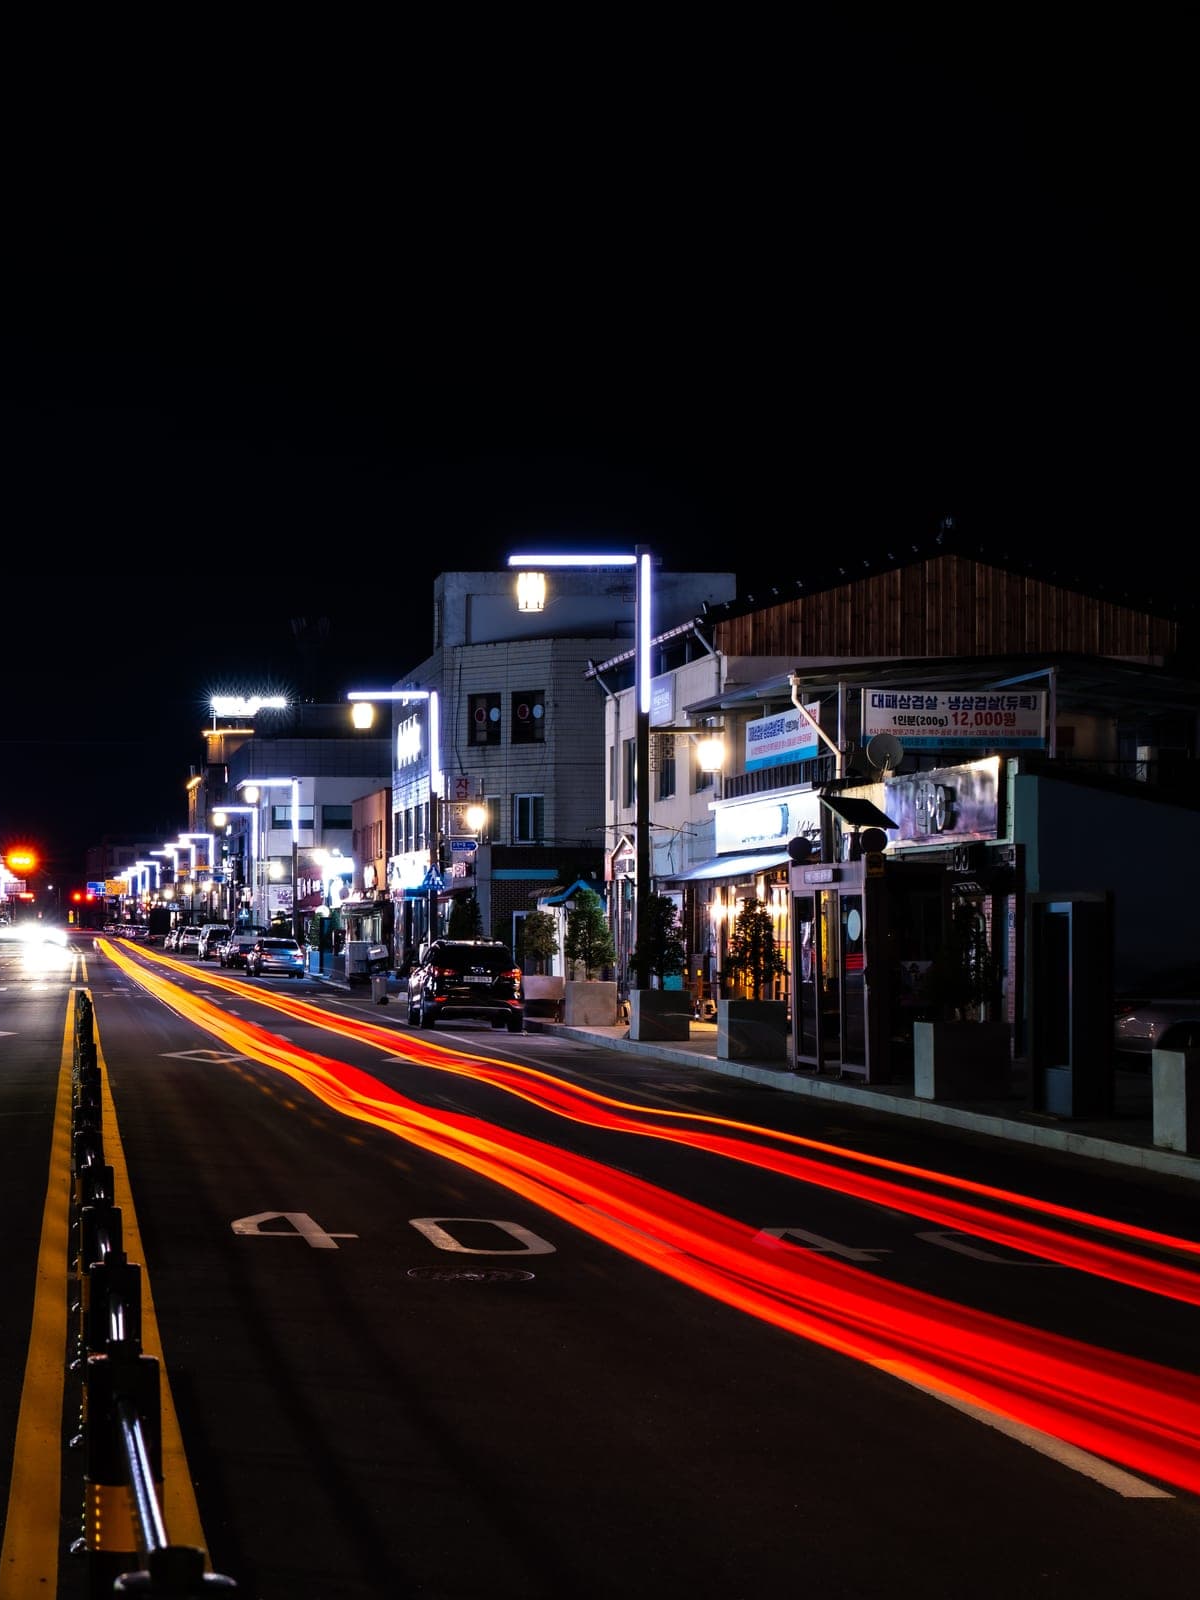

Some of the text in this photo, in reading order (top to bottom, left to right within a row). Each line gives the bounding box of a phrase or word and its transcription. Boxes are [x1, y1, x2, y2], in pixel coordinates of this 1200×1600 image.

[871, 693, 938, 711] 대패삼겹살
[892, 711, 1017, 728] 1인분(200g) 12,000원
[230, 1211, 557, 1255] 40
